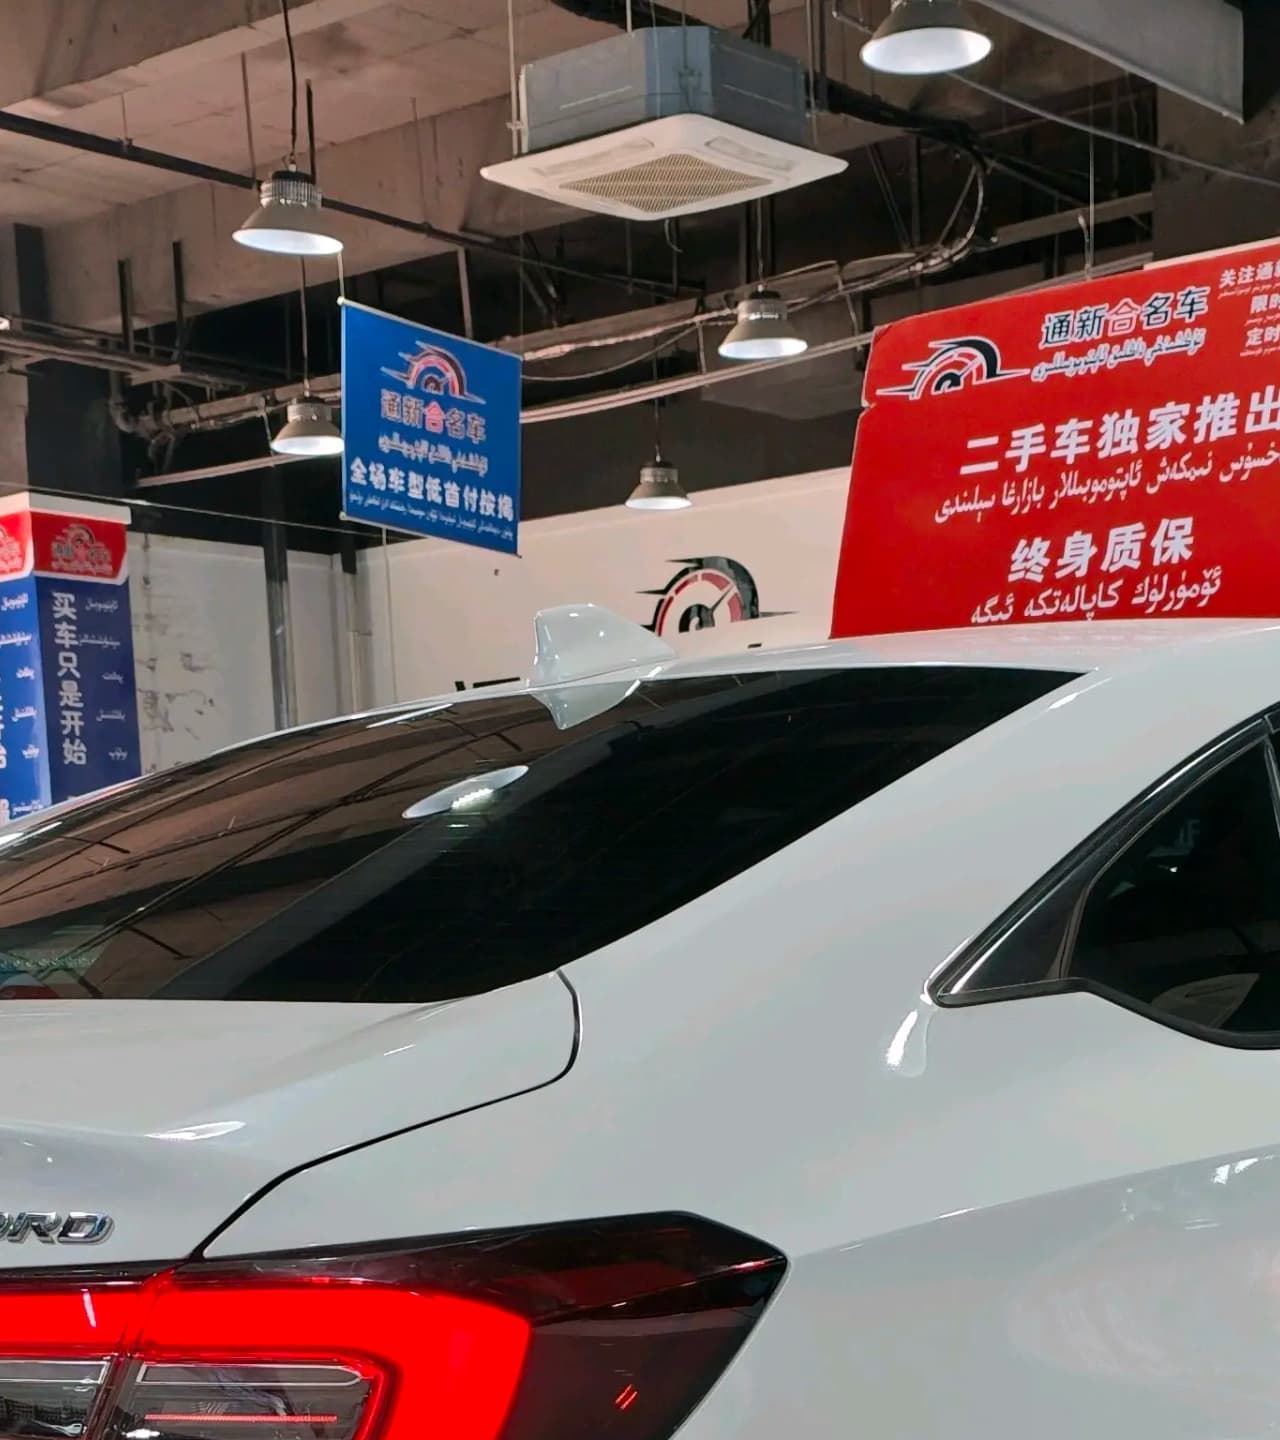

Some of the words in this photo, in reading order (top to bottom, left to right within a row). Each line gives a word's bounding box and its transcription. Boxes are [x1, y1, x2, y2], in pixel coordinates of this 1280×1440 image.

[1038, 285, 1211, 350] 通新合名车
[1007, 516, 1195, 585] 终身质保
[51, 591, 88, 766] 买车只是开始
